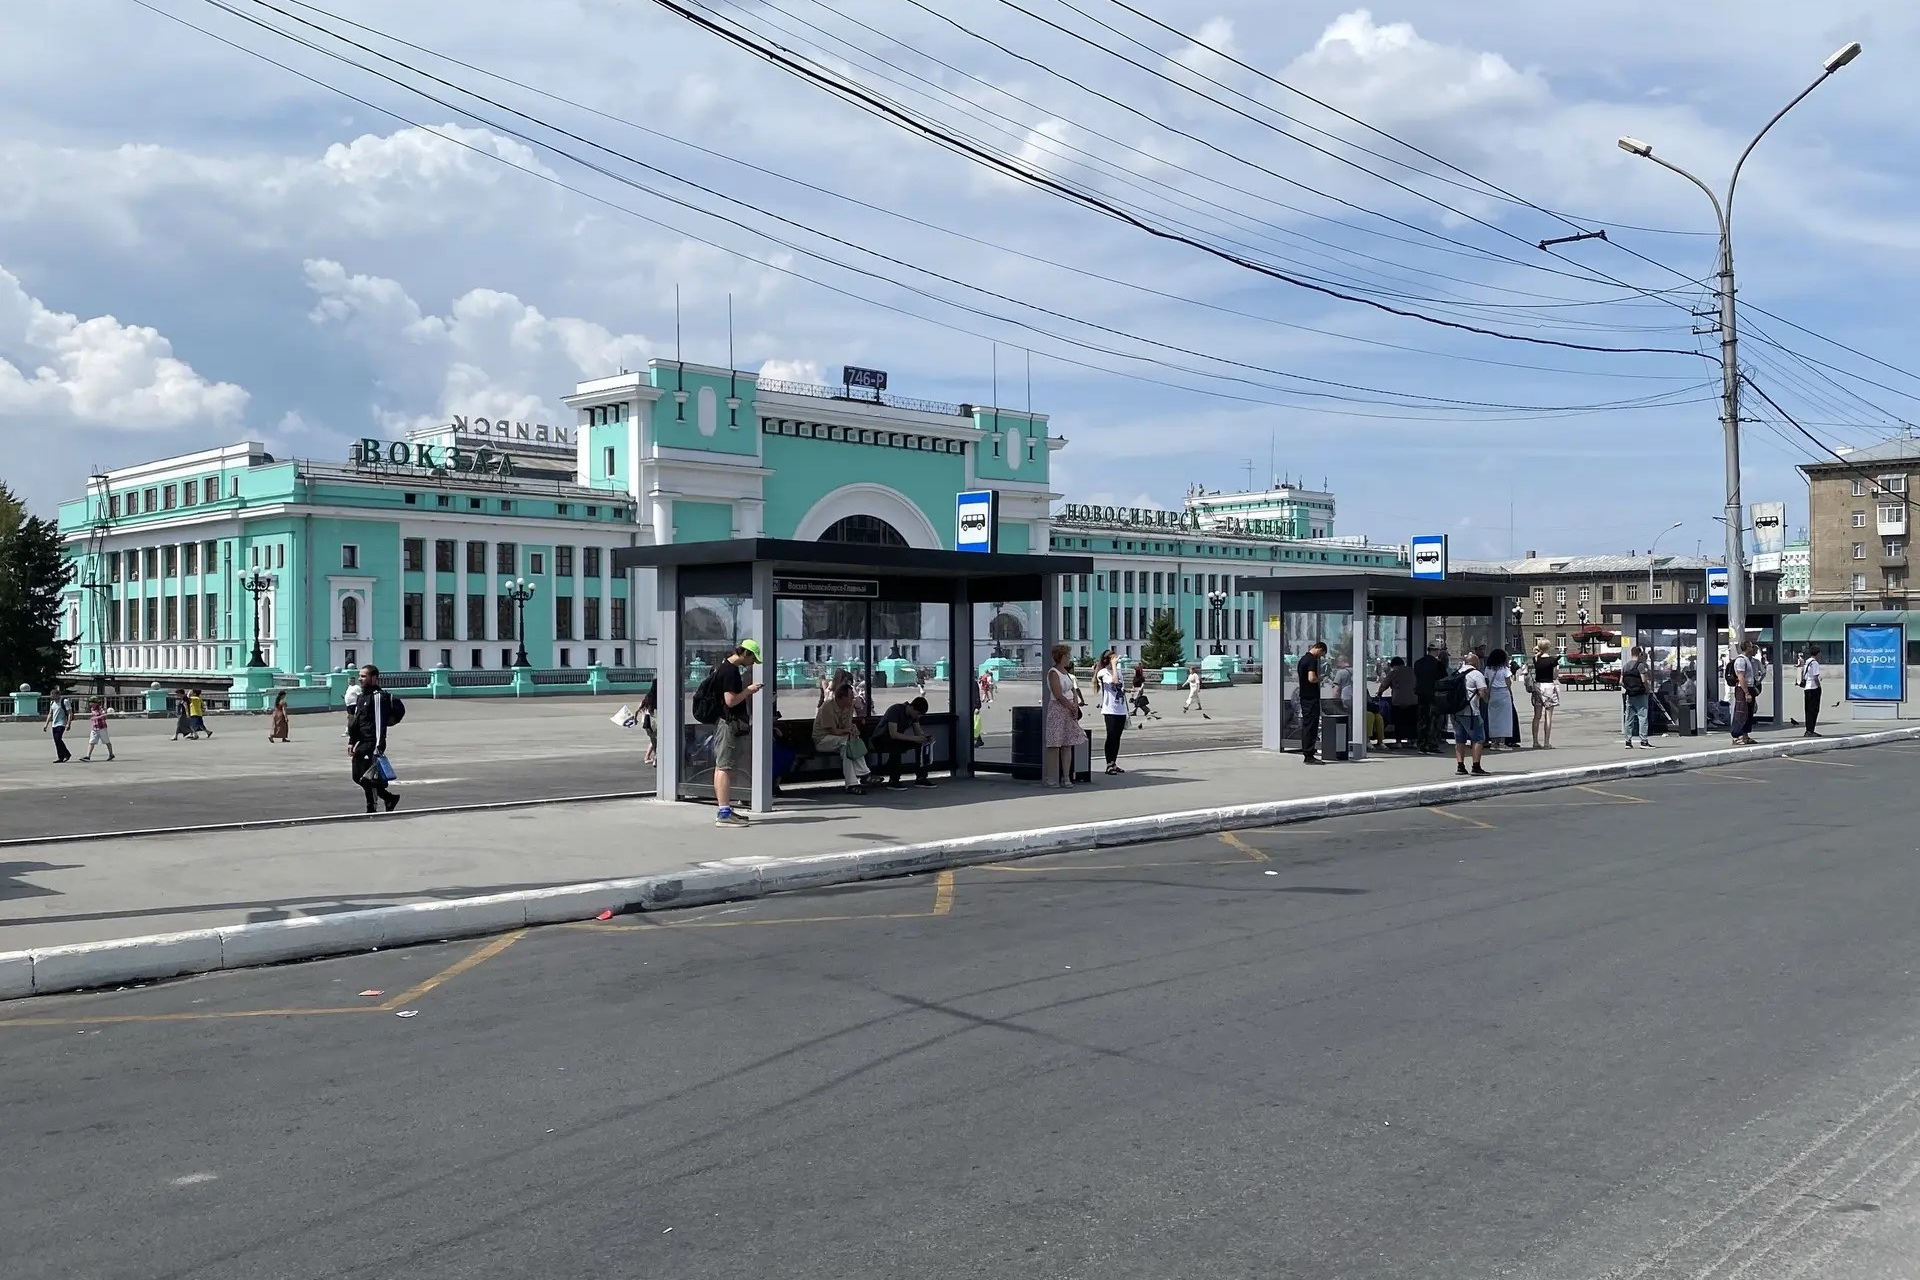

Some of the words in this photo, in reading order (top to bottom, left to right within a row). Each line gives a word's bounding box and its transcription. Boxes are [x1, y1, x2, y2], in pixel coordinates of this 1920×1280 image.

[361, 438, 516, 476] ВОКЗАЛ
[1065, 503, 1201, 531] НОВОСИБИРСК
[1226, 516, 1296, 537] ГЛАВНЫЙ
[1850, 656, 1896, 664] ДОБРОМ
